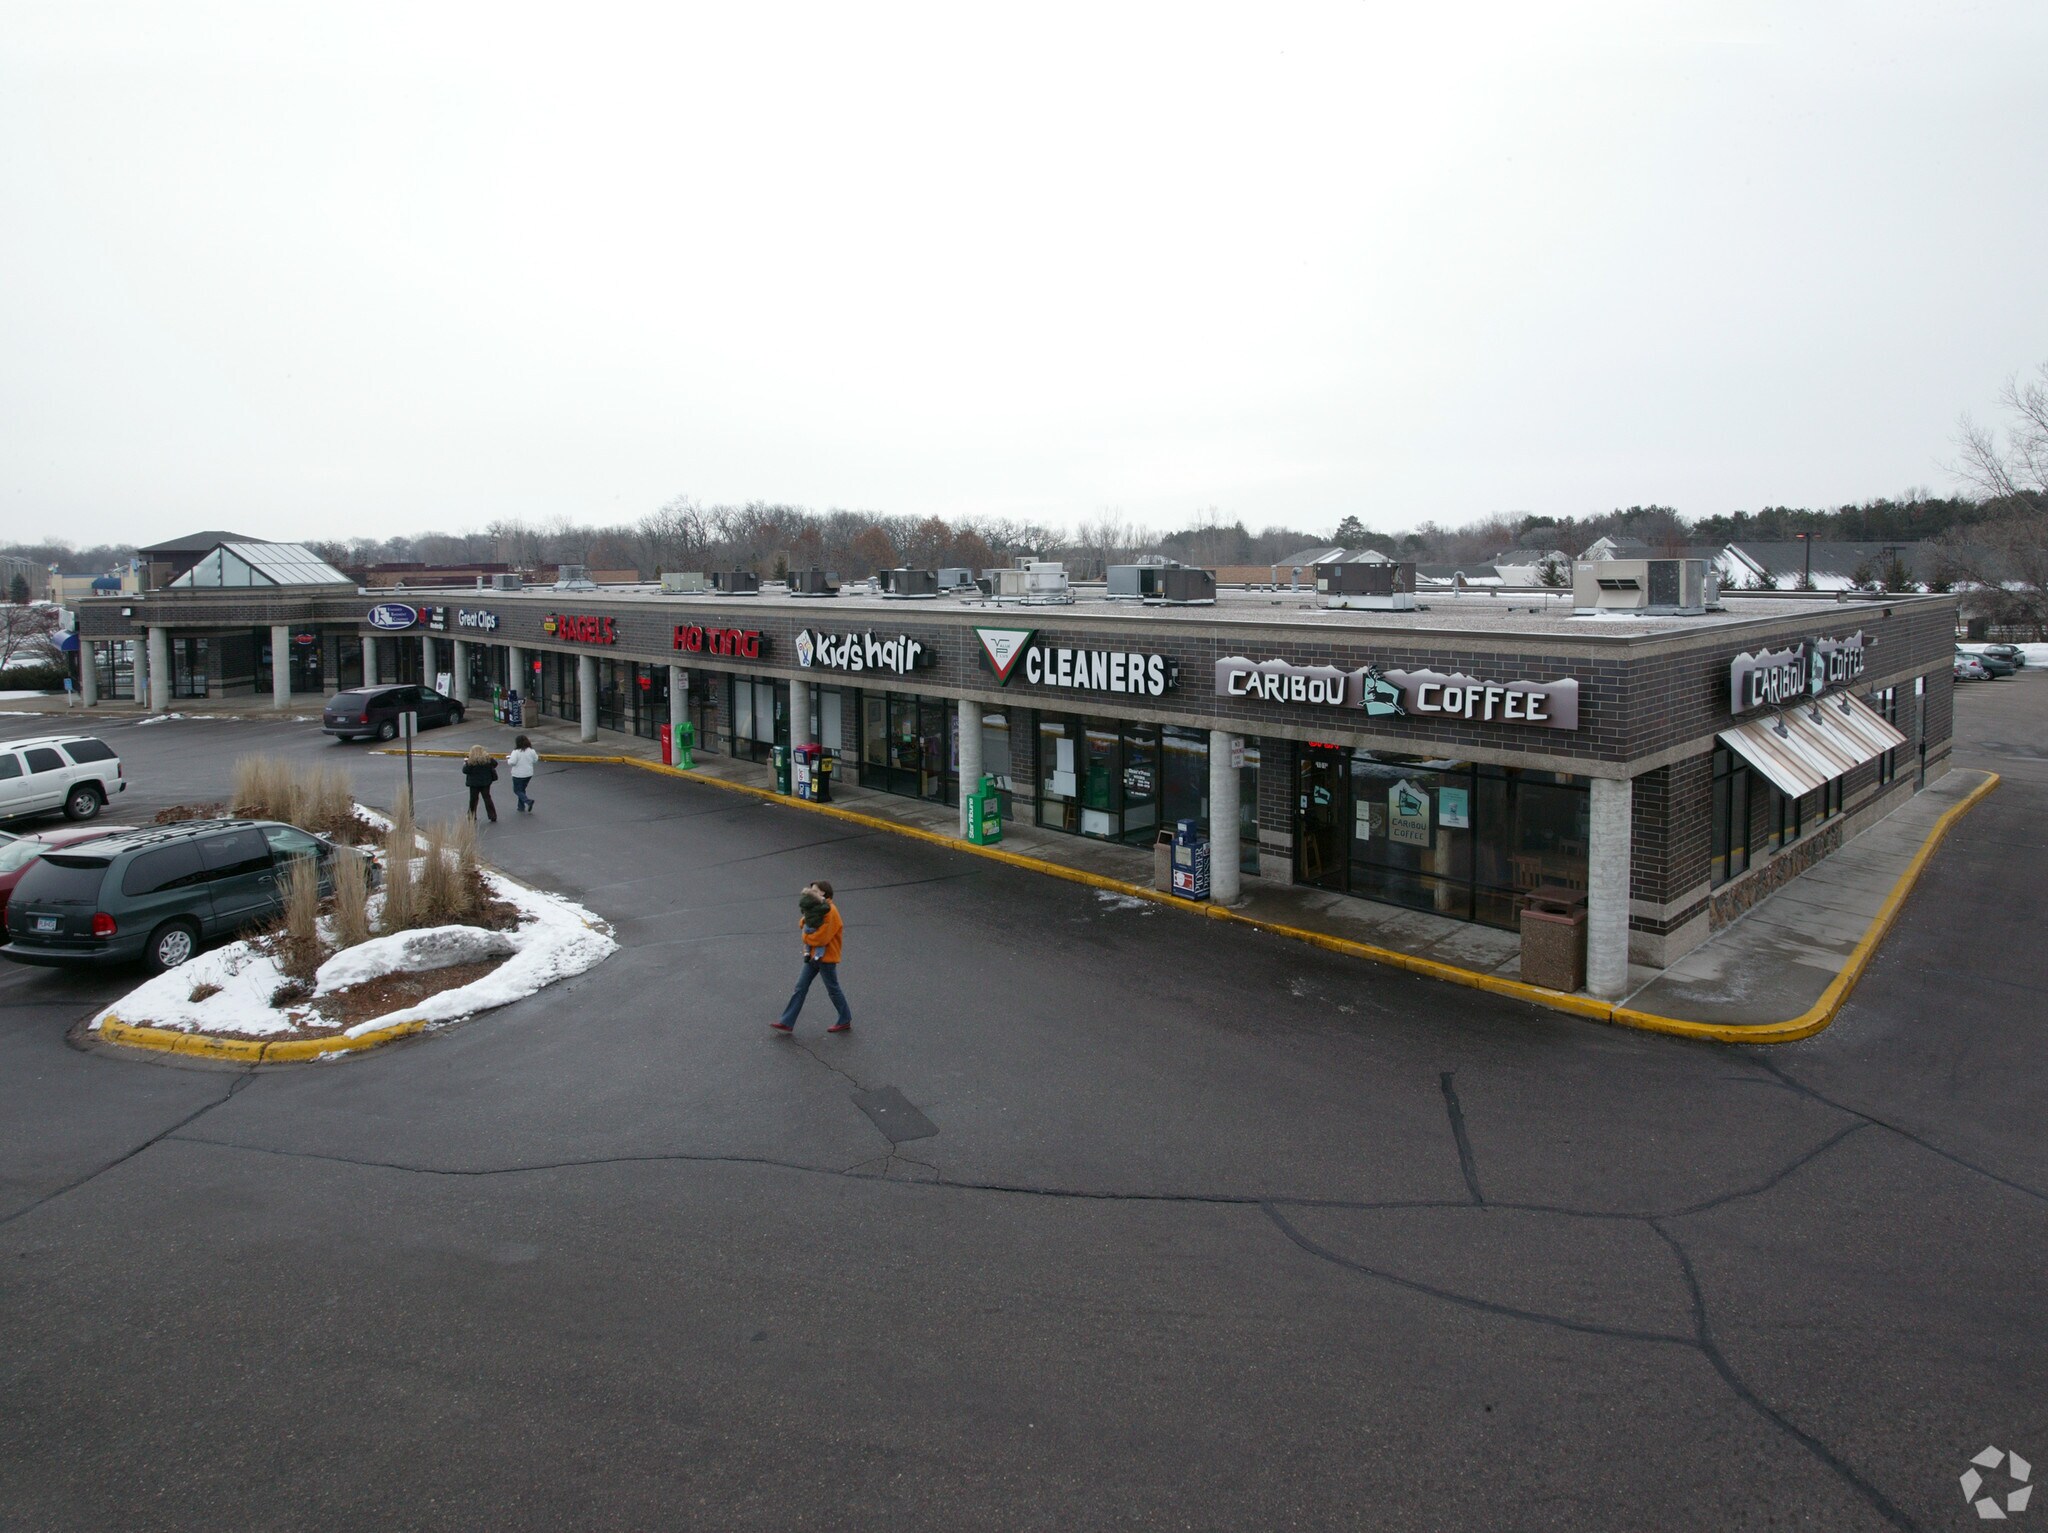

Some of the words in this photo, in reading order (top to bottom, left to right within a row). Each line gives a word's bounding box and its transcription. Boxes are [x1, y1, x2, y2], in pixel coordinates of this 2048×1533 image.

[458, 609, 478, 627] Great
[478, 610, 496, 632] Clips
[558, 614, 614, 645] BAGELS
[673, 625, 702, 653] HO
[1026, 646, 1164, 696] CLEANERS
[1752, 657, 1806, 706] CARIBOU
[1829, 646, 1864, 681] COFFEE
[1227, 670, 1345, 705] CARIBOU
[1416, 682, 1549, 721] COFFEE
[1391, 817, 1428, 831] CARIBOU
[1393, 828, 1424, 840] COFFEE
[1194, 846, 1204, 894] PIONEER
